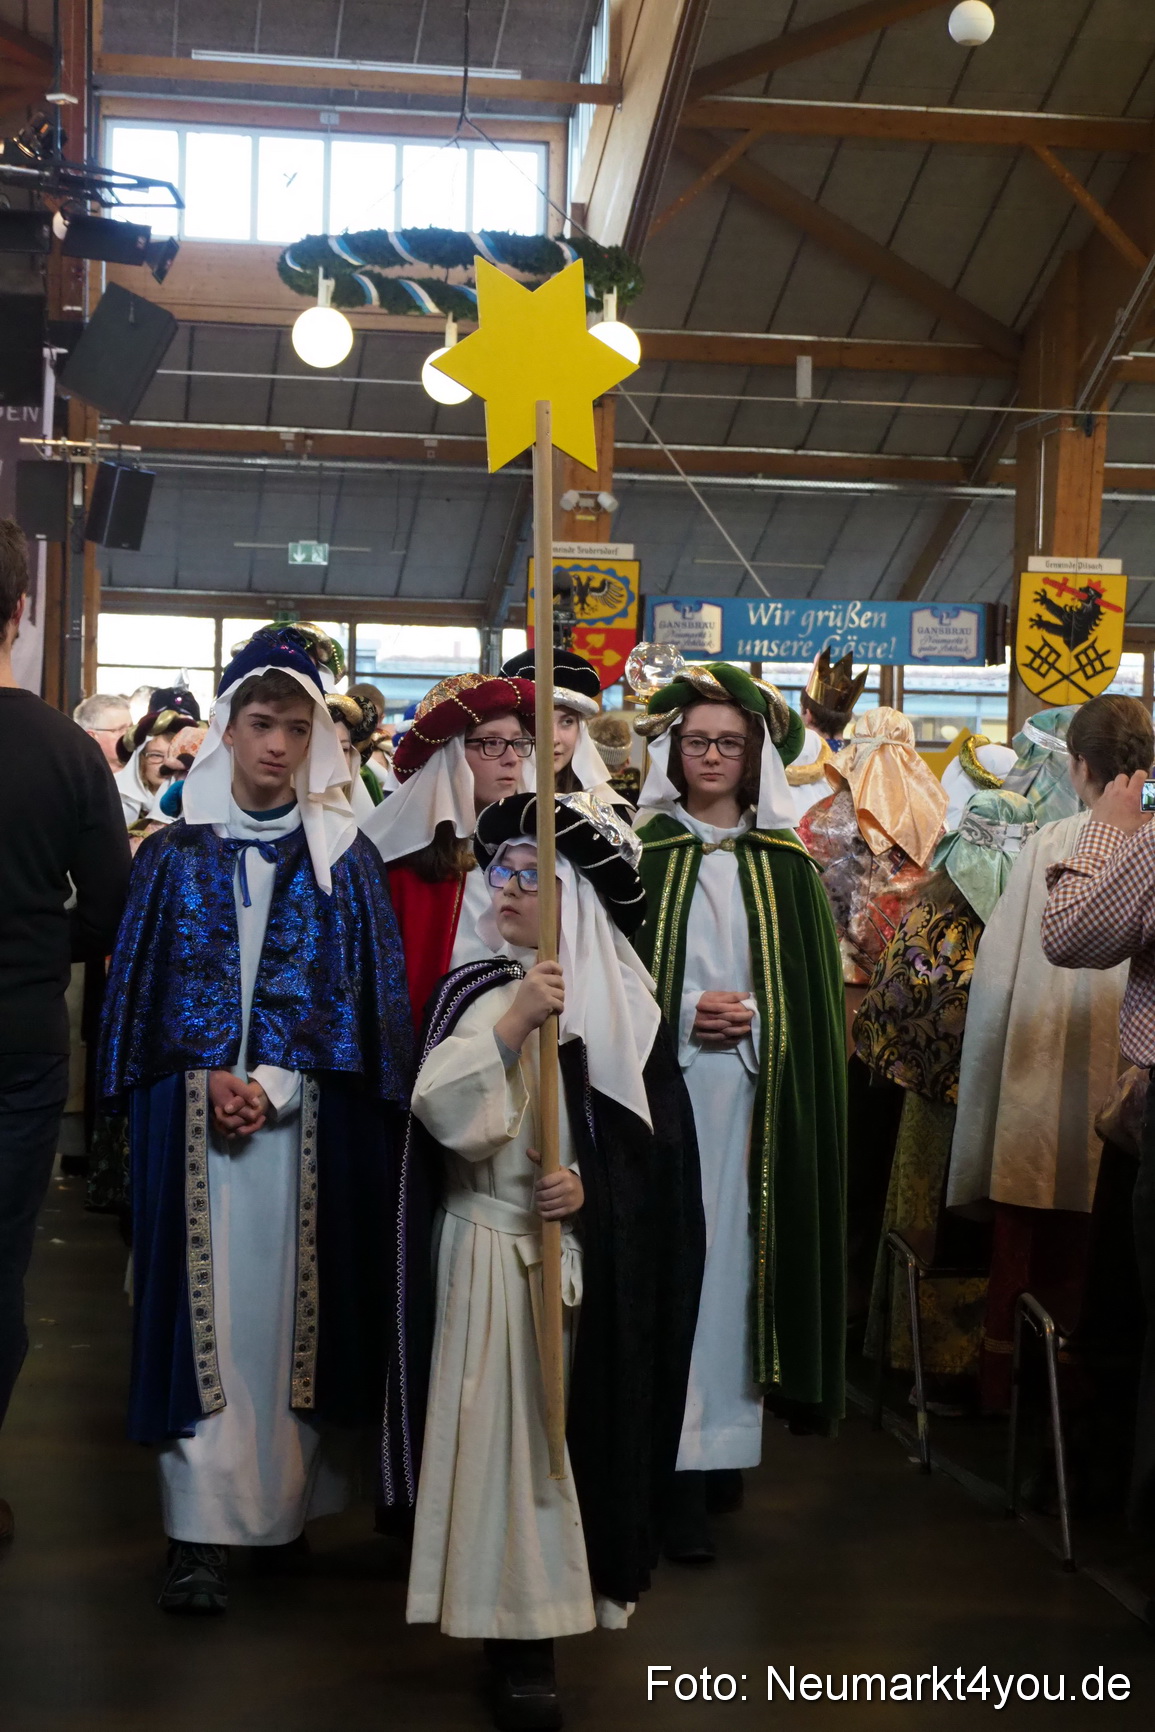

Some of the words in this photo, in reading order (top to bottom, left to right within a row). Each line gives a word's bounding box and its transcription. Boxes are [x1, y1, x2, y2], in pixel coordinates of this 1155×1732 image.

[747, 602, 796, 627] Wir
[798, 600, 887, 638] grüßen
[737, 638, 814, 658] unsere
[821, 635, 897, 659] Gäste!
